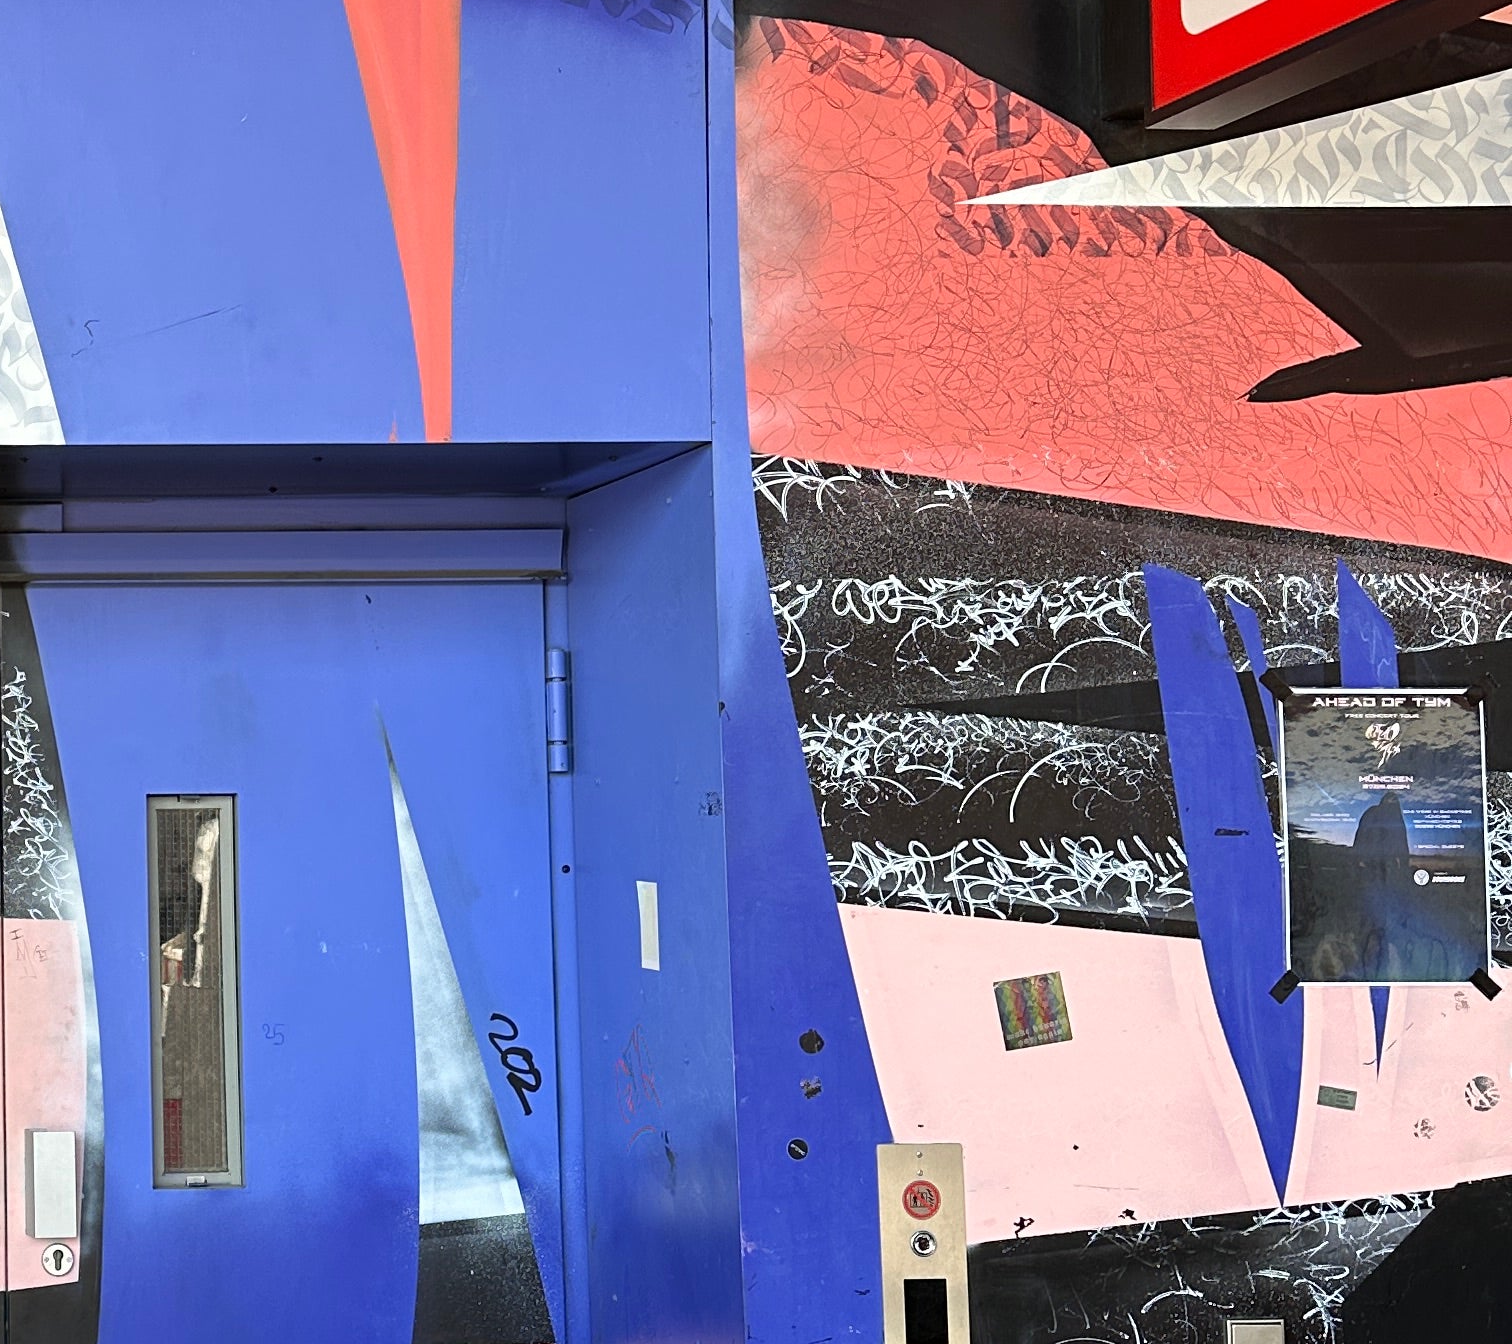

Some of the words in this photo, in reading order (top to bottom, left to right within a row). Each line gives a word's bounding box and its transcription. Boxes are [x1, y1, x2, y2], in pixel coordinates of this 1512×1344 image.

[1311, 697, 1376, 708] AHEAD
[1381, 697, 1407, 708] OF
[1411, 697, 1452, 709] TYM
[1358, 774, 1414, 783] MÜNCHEN
